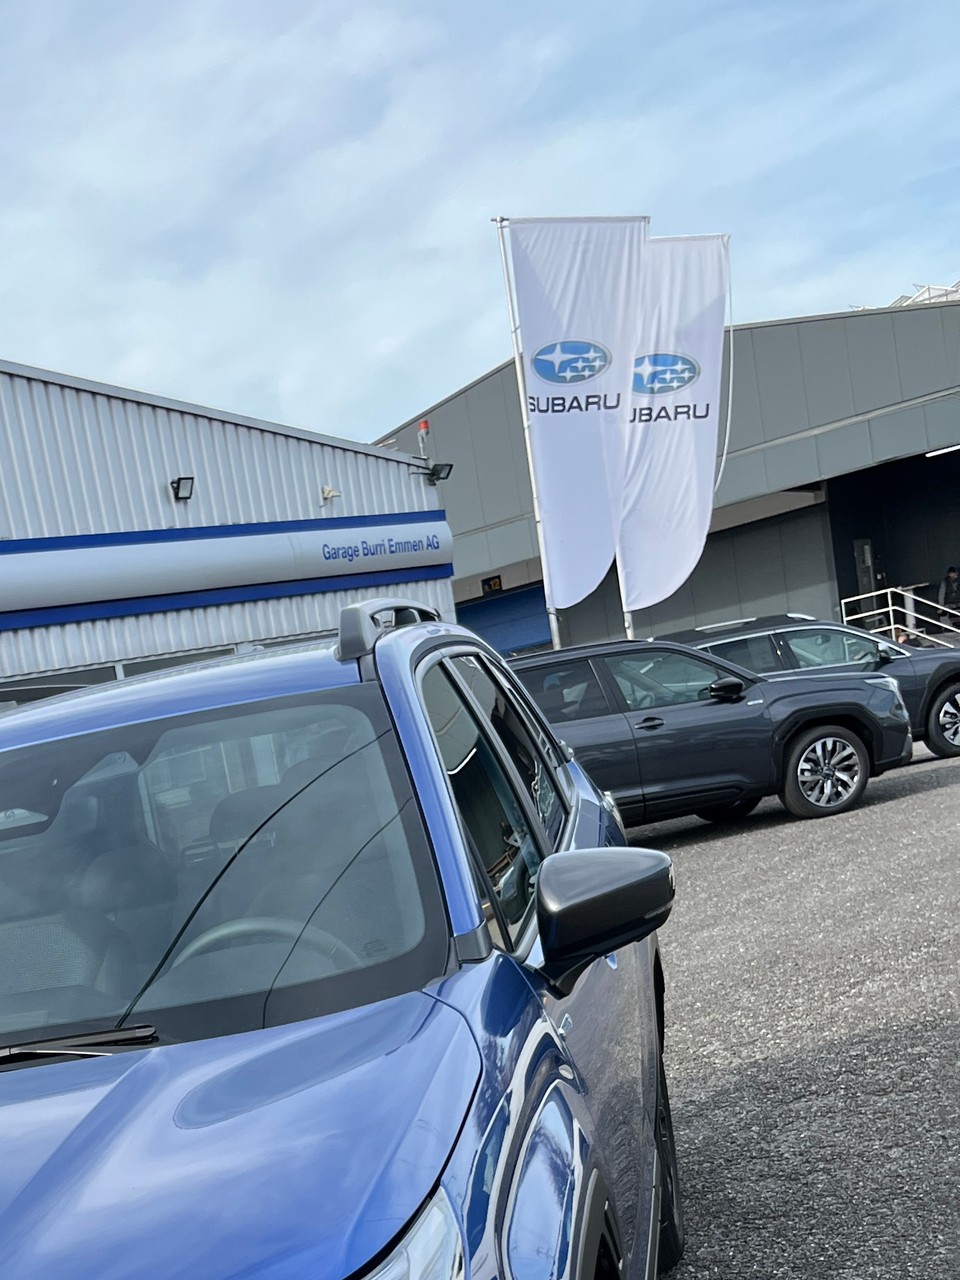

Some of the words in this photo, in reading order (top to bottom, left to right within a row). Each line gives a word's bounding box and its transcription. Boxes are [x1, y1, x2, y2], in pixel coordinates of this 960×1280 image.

[322, 544, 360, 562] Garage
[361, 540, 387, 556] Burri
[387, 538, 424, 554] Emmen
[426, 534, 440, 550] AG
